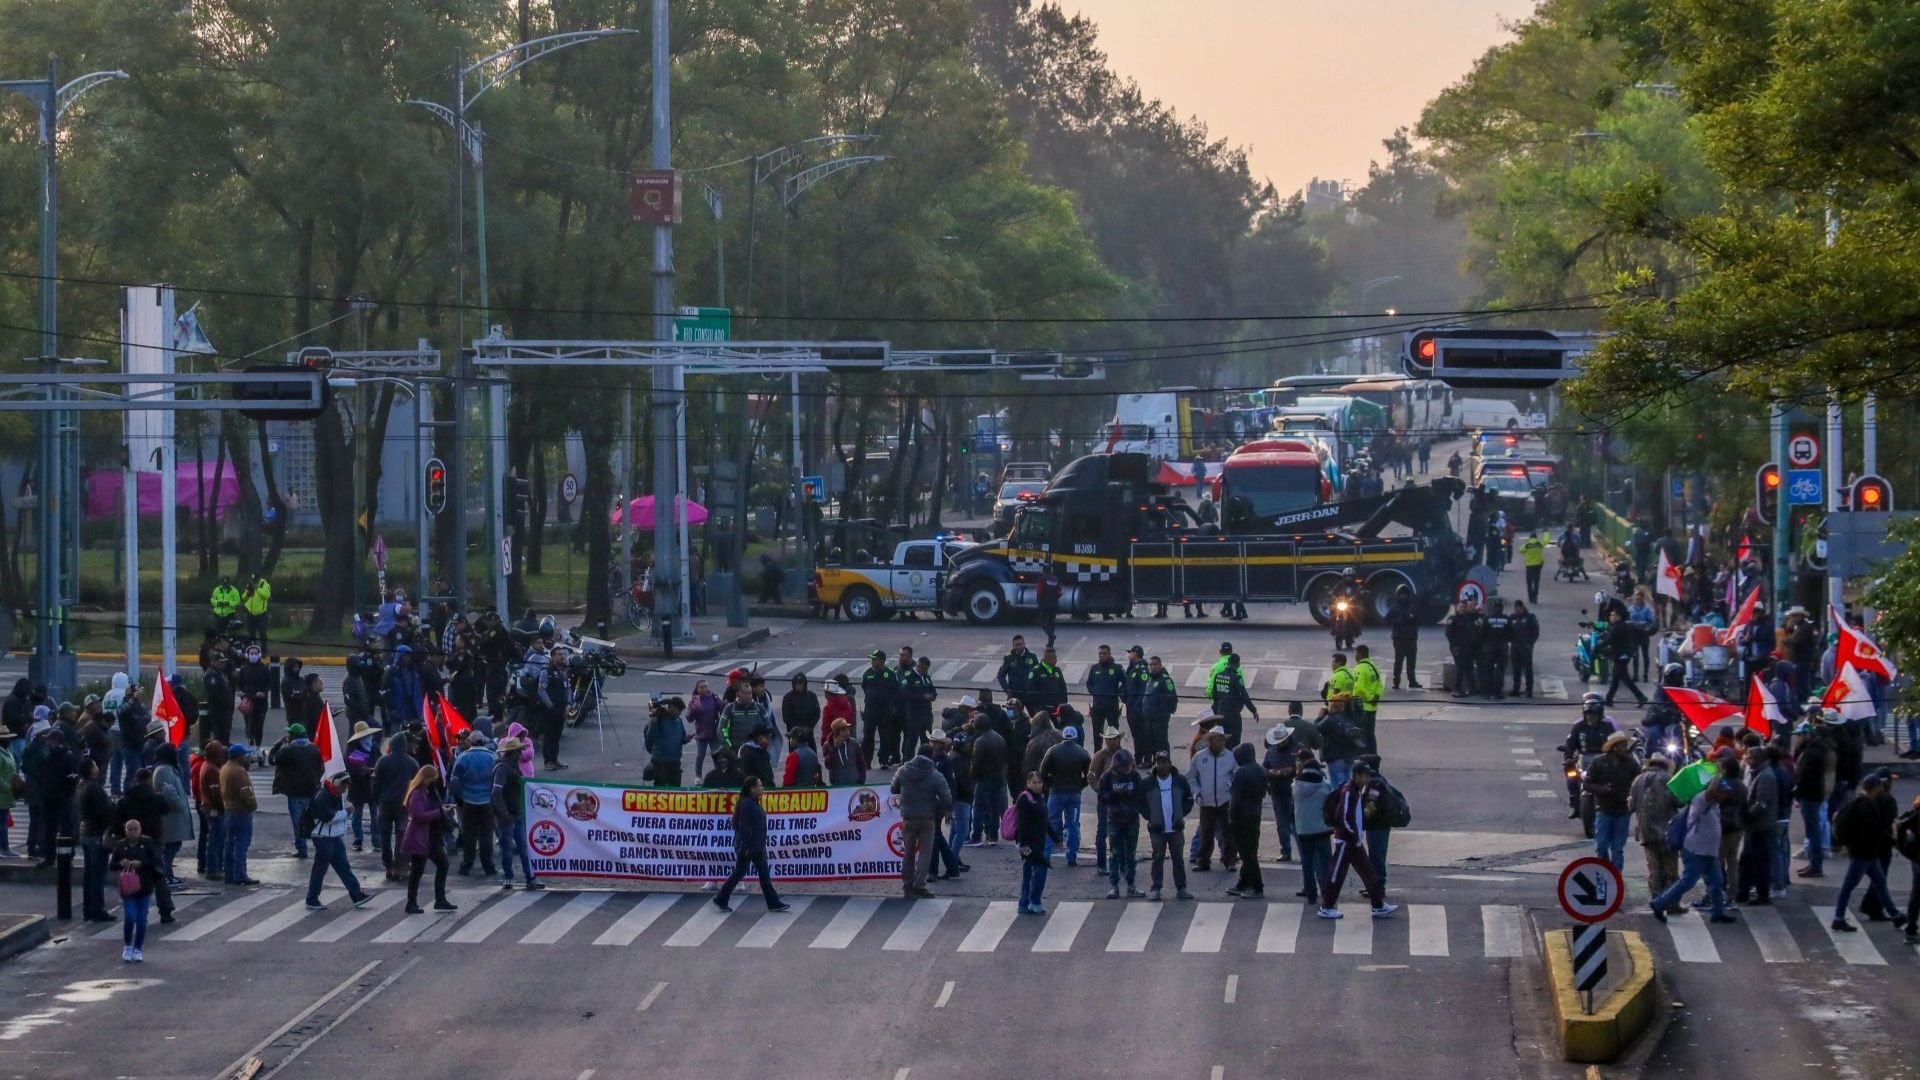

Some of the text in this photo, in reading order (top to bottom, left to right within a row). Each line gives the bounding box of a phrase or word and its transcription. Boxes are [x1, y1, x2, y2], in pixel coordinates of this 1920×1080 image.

[684, 327, 725, 342] RIO CONSULADO
[567, 480, 574, 490] 50
[1274, 506, 1339, 526] JERR-DAN
[625, 791, 826, 813] PRESIDENTE SINBAUM
[632, 817, 666, 829] FUERA
[669, 818, 714, 830] GRANOS
[768, 818, 785, 830] DEL
[788, 818, 818, 830] TMEC
[587, 829, 634, 843] PRECIOS
[636, 832, 650, 843] DE
[652, 832, 708, 847] GARANTÍA
[779, 834, 800, 846] LAS
[801, 829, 862, 845] COSECHAS
[619, 847, 659, 859] BANCA
[660, 849, 675, 860] DE
[676, 850, 737, 861] DESARROLL
[777, 849, 791, 859] EL
[792, 846, 833, 859] CAMPO
[531, 859, 567, 871] NUEVO
[569, 859, 613, 873] MODELO
[615, 863, 630, 873] DE
[630, 864, 707, 876] AGRICULTURA
[774, 863, 835, 876] SEGURIDAD
[837, 862, 852, 875] EN
[854, 860, 903, 874] CARRETE
